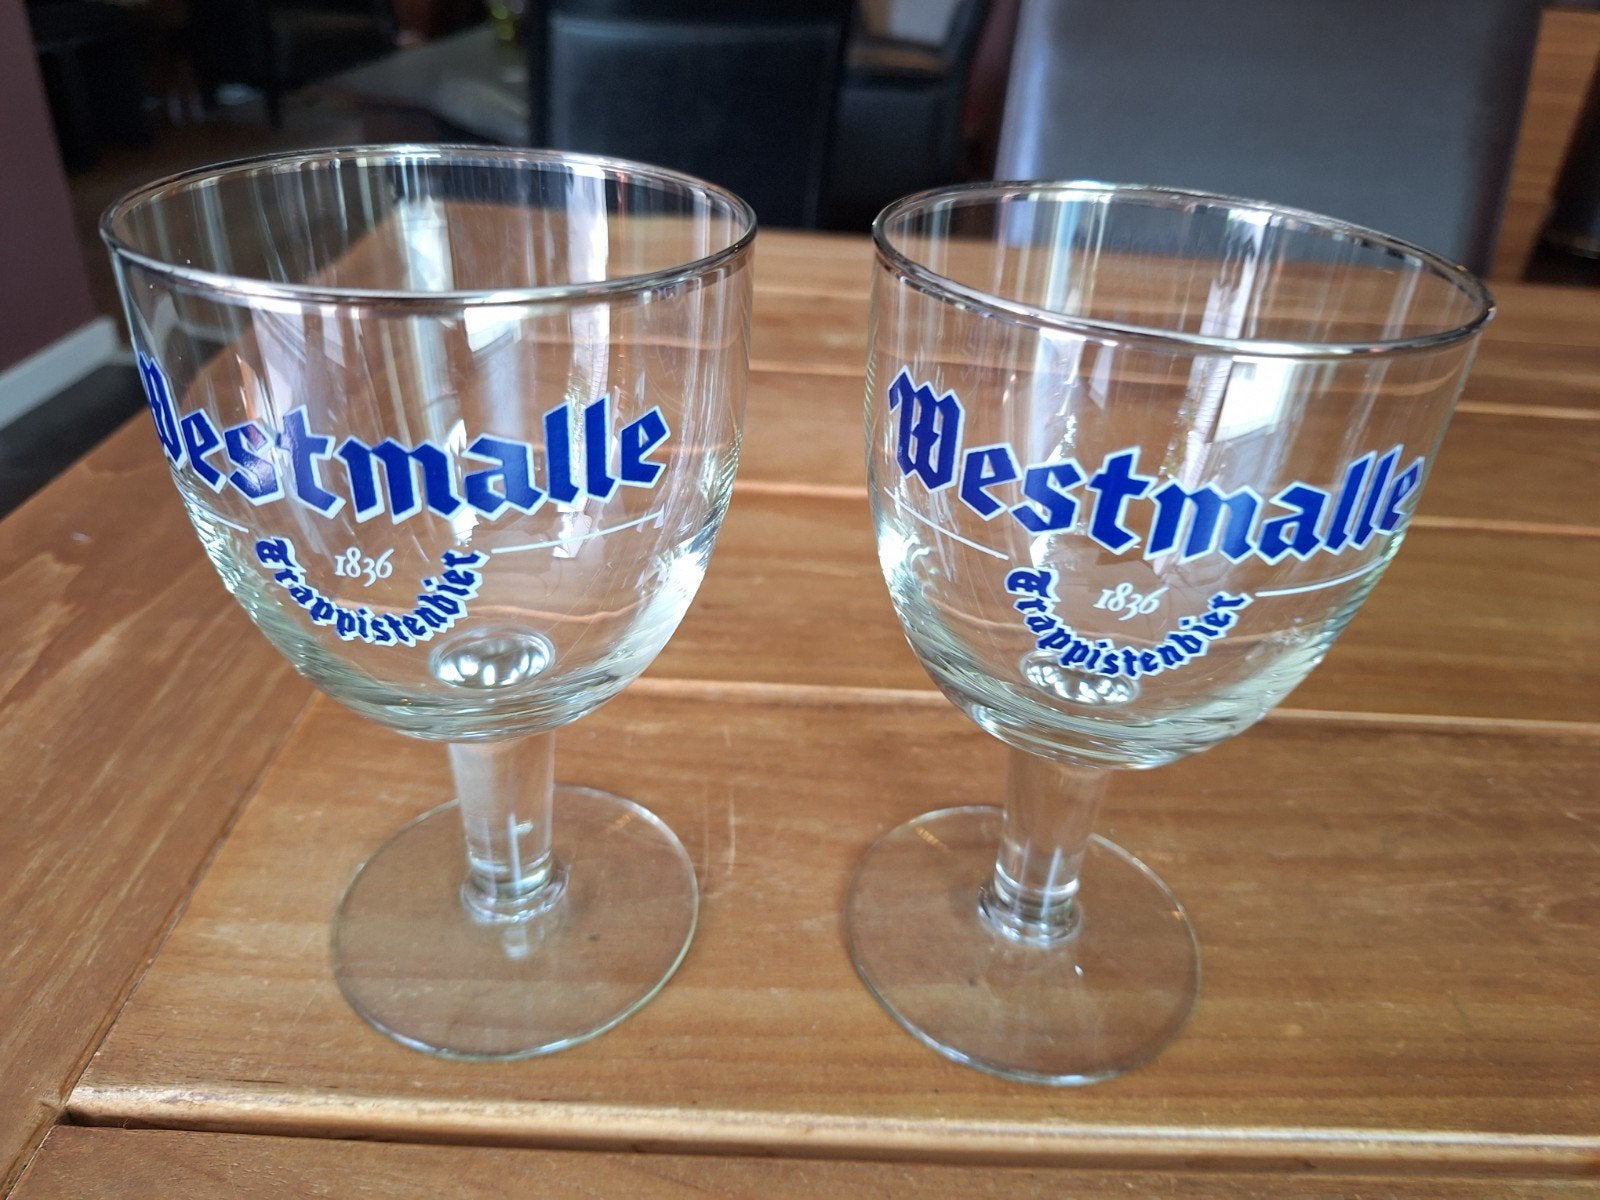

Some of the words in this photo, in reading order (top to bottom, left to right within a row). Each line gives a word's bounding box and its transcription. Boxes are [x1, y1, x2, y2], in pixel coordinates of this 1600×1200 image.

[136, 352, 670, 524] Westmalle
[888, 365, 1426, 566] Westmalle
[254, 536, 490, 647] Trappistenbier
[333, 547, 395, 588] 1836
[1004, 567, 1254, 680] Trappistenbier
[1093, 582, 1170, 622] 1836
